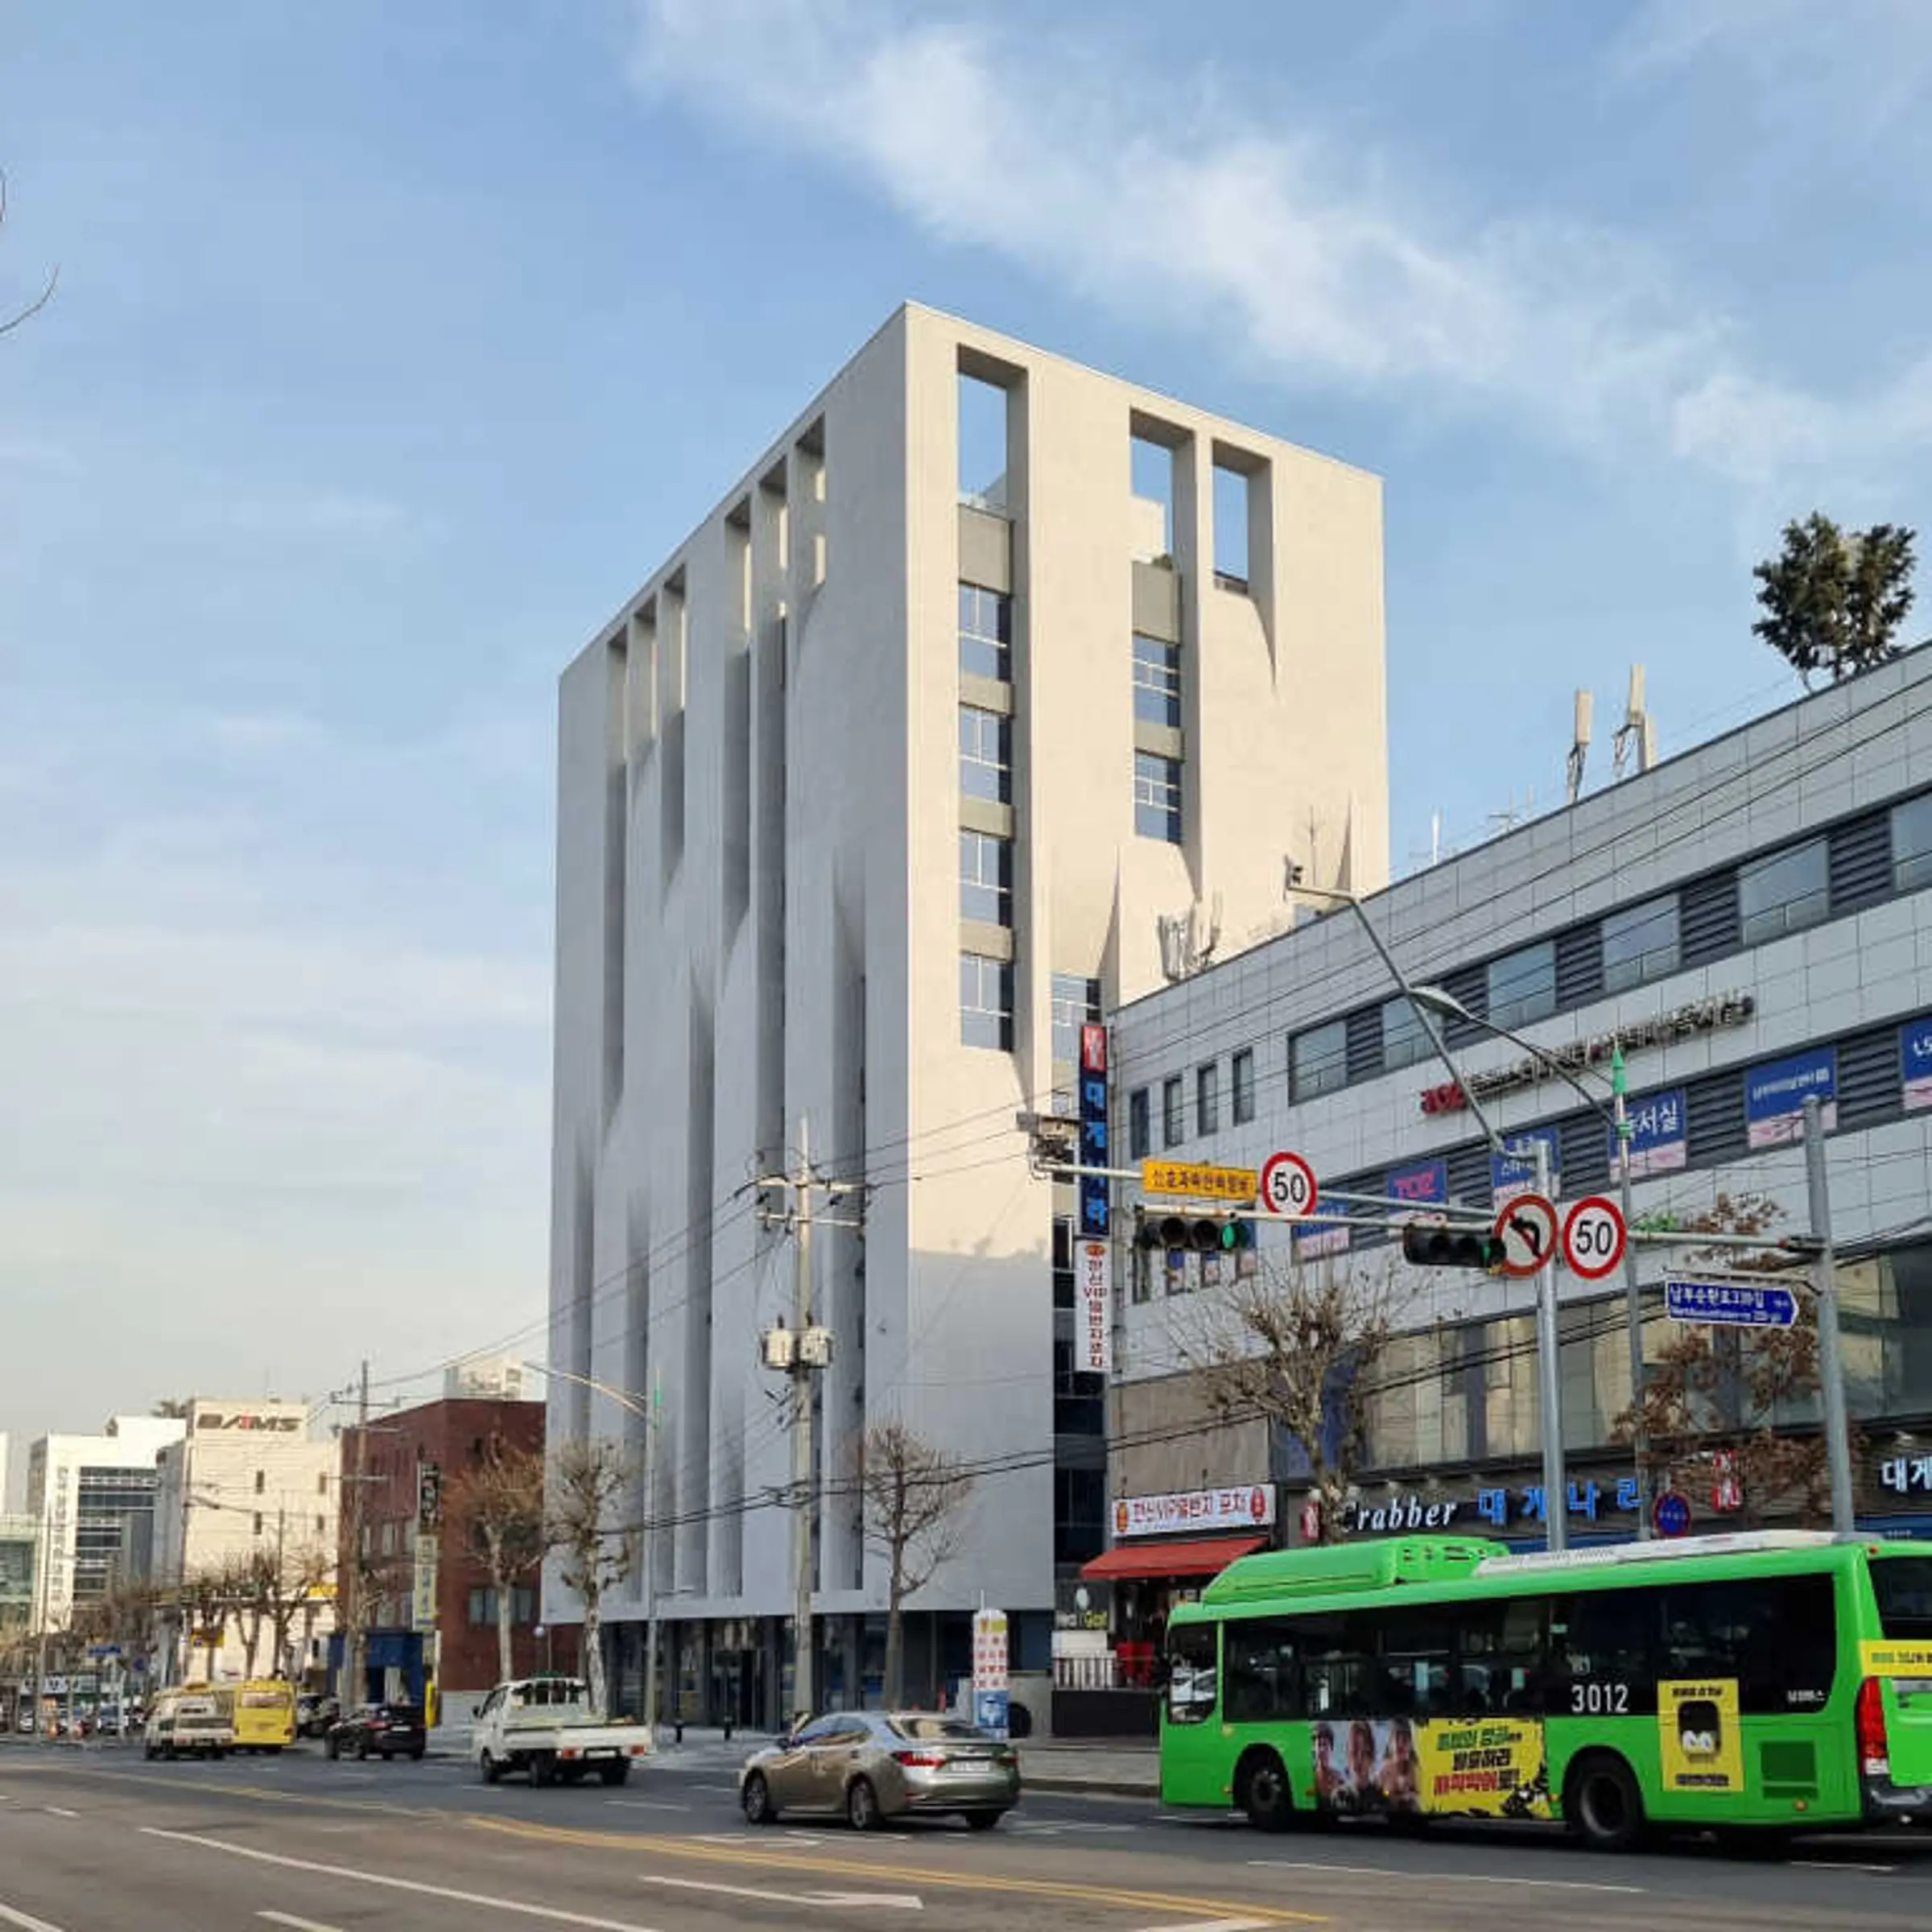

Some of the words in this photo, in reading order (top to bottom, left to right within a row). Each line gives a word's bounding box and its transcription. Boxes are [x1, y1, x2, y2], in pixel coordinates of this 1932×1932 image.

[1273, 1171, 1307, 1203] 50
[1577, 1220, 1613, 1256] 50
[1343, 1497, 1458, 1533] Crabber
[1571, 1684, 1629, 1713] 3012
